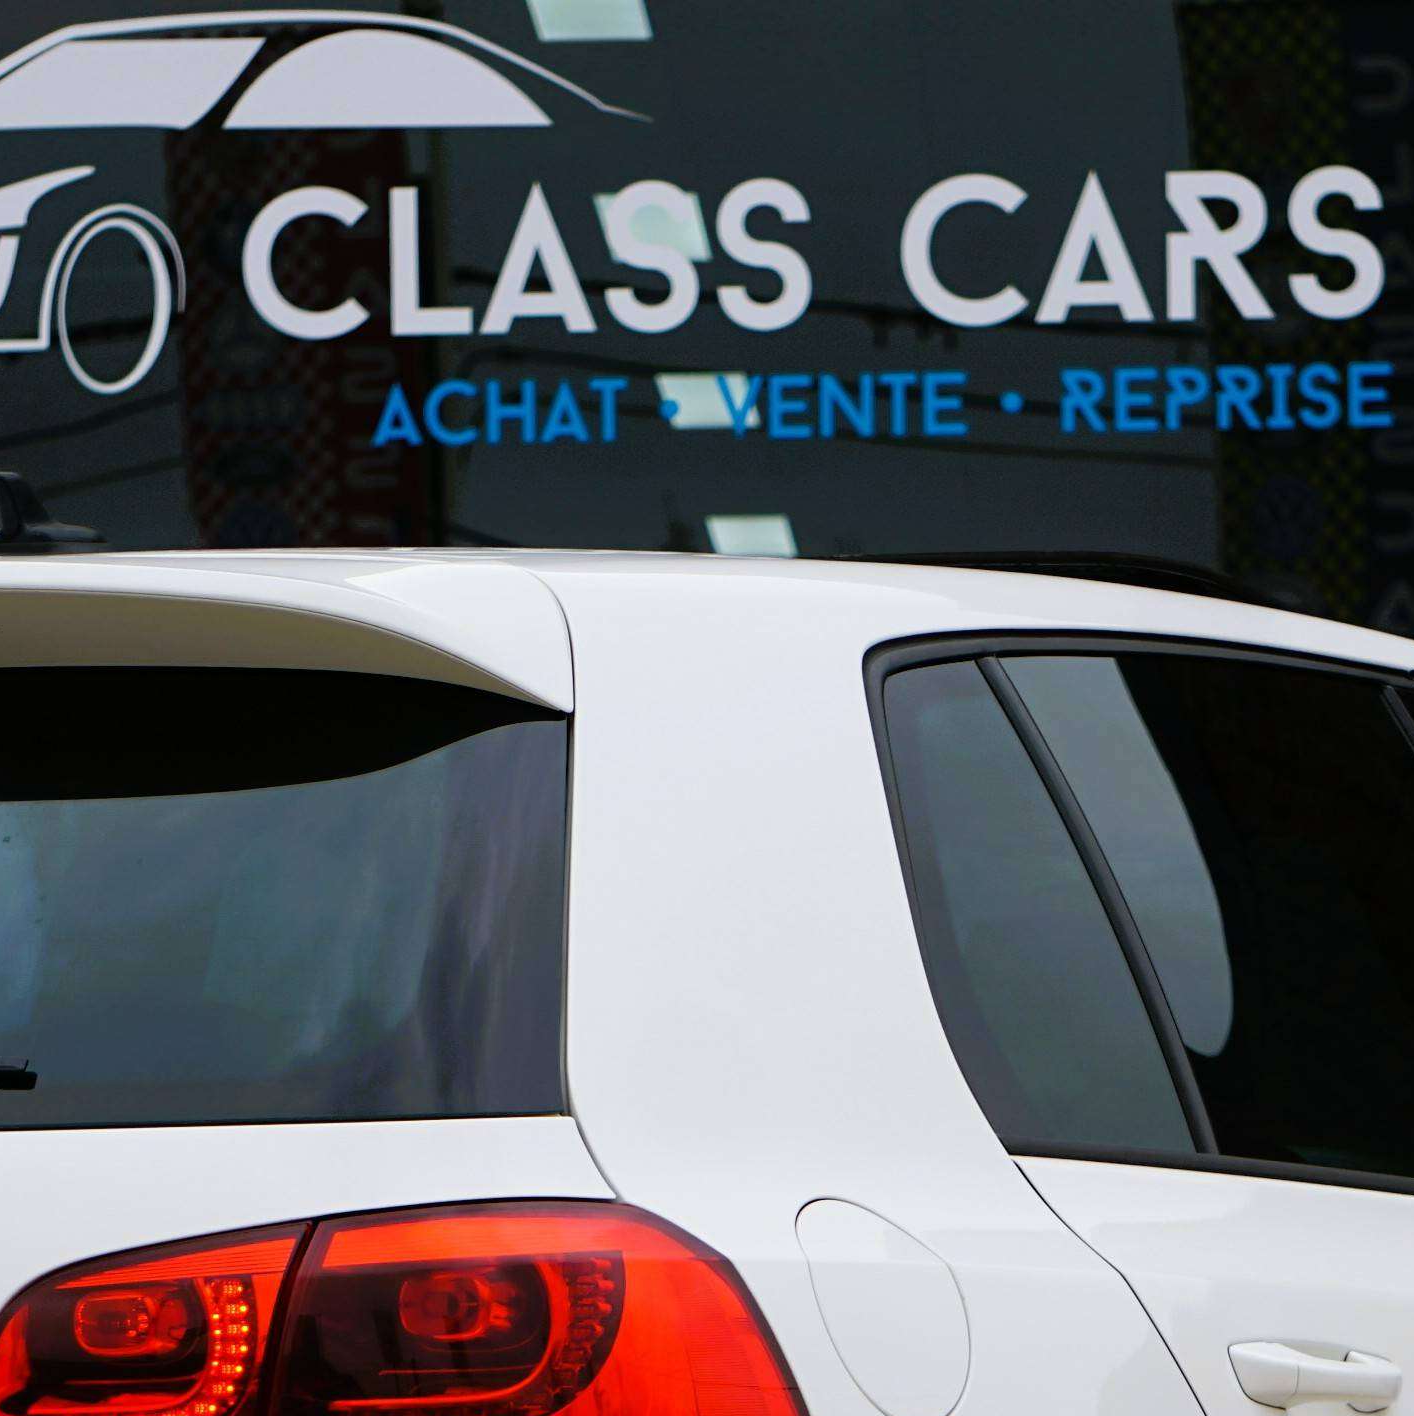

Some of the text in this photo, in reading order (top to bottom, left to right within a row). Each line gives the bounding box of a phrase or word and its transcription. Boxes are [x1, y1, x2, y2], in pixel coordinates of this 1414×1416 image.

[243, 166, 1383, 339] CLASS CARS
[373, 363, 1393, 447] ACHAT VENTE REPRISE
